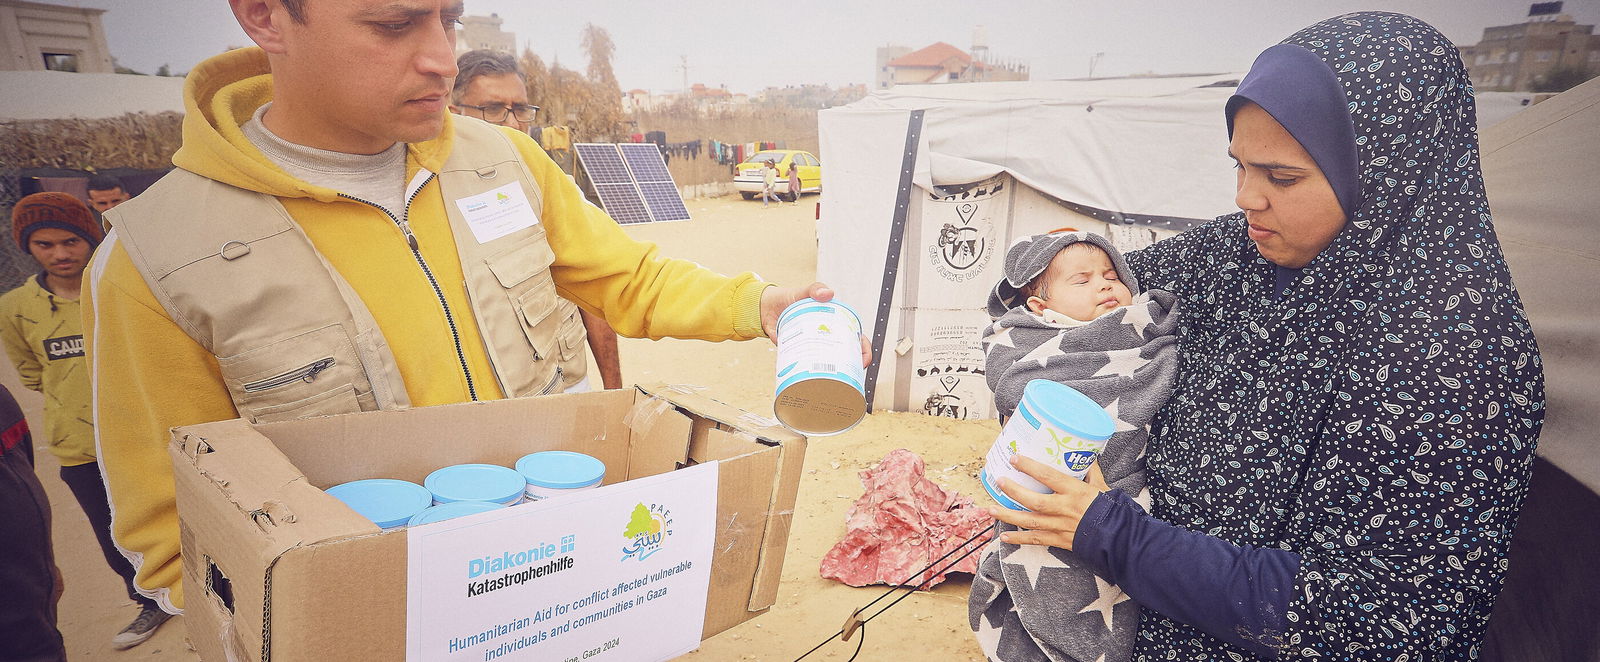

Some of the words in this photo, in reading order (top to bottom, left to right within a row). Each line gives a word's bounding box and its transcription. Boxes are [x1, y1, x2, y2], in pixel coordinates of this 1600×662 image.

[651, 503, 673, 536] PAEEP
[467, 556, 574, 597] Katastrophenhilfe
[468, 542, 556, 579] Diakonie
[449, 617, 530, 653] Humanitarian
[533, 606, 552, 624] Aid
[555, 604, 571, 616] for
[572, 589, 610, 611] conflict
[612, 574, 648, 597] affected
[650, 560, 692, 583] vulnerable
[485, 630, 547, 662] individuals
[550, 620, 570, 638] and
[572, 600, 634, 630] communities
[636, 595, 644, 606] in
[646, 587, 668, 601] Gaza
[582, 647, 601, 660] Gaza
[602, 637, 620, 651] 2024
